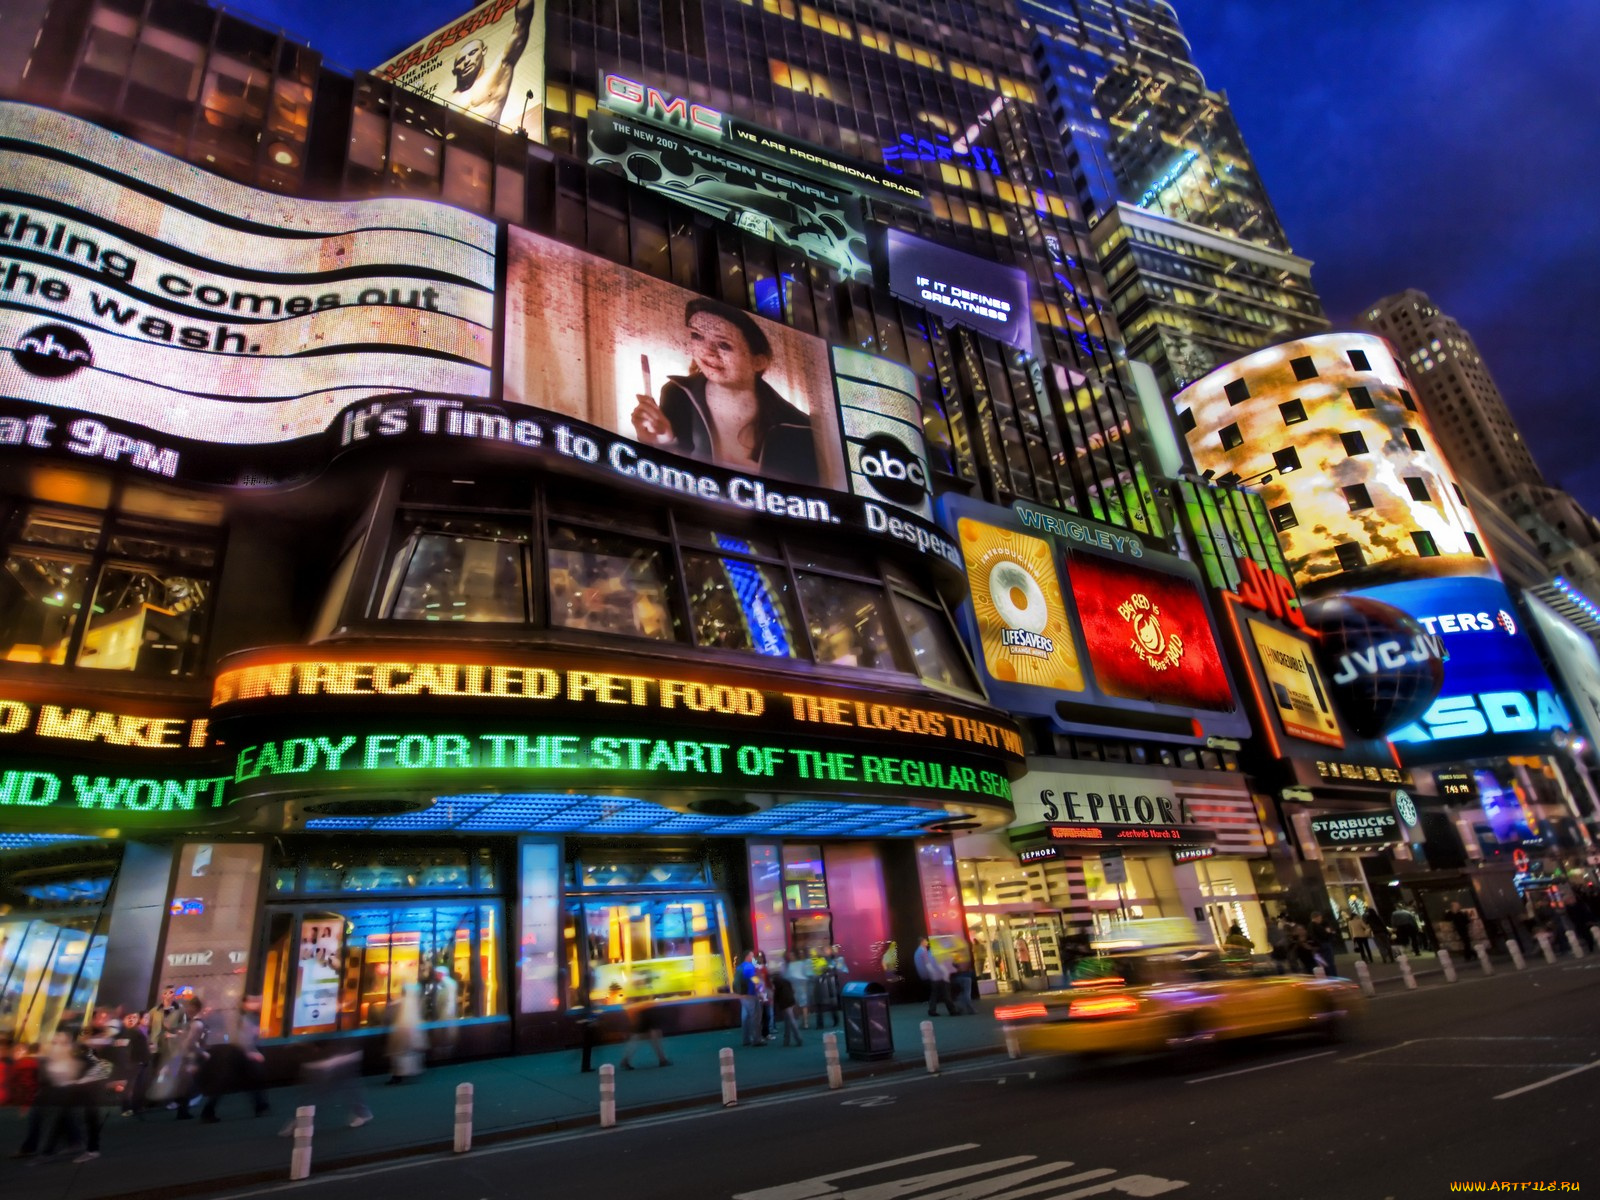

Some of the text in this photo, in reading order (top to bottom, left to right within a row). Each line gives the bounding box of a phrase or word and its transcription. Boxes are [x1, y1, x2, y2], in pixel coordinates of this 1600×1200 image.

[420, 55, 439, 71] NEW
[606, 74, 722, 131] GMC
[612, 121, 678, 151] THE NEW 2007
[683, 145, 840, 204] YUKON DENALI
[737, 129, 925, 199] WE ARE PROFESSIONAL GRADE.
[158, 272, 341, 316] comes
[357, 286, 440, 311] out
[916, 275, 1011, 312] IF IT DEFINES
[921, 289, 1008, 322] GREATNESS
[90, 290, 262, 354] wash.
[0, 413, 57, 448] at
[341, 401, 409, 447] It's
[412, 398, 544, 448] Time
[553, 422, 599, 463] to
[608, 441, 720, 500] Come
[728, 476, 841, 525] Clean.
[860, 449, 925, 487] abc
[1016, 506, 1143, 558] WRIGLEY'S
[1131, 593, 1150, 611] RED
[1237, 556, 1307, 630] JVC
[1130, 638, 1145, 661] THE
[1333, 641, 1407, 685] JVC
[297, 662, 560, 700] RECALLED
[566, 670, 657, 707] PET
[659, 678, 765, 717] FOOD
[782, 692, 853, 727] THE
[852, 701, 947, 738] LOGOS
[945, 714, 1000, 748] THAT
[36, 704, 187, 749] MAKE
[234, 735, 357, 784] EADY
[363, 735, 474, 769] FOR
[479, 734, 580, 768] THE
[591, 737, 731, 774] START
[736, 745, 785, 776] OF
[788, 749, 858, 782] THE
[861, 755, 980, 793] REGULAR
[72, 774, 235, 811] WON'T
[1311, 815, 1396, 832] STARBUCKS
[1330, 827, 1384, 840] COFFEE
[1021, 847, 1057, 860] SEPHORA
[1175, 848, 1214, 860] SEPHORA
